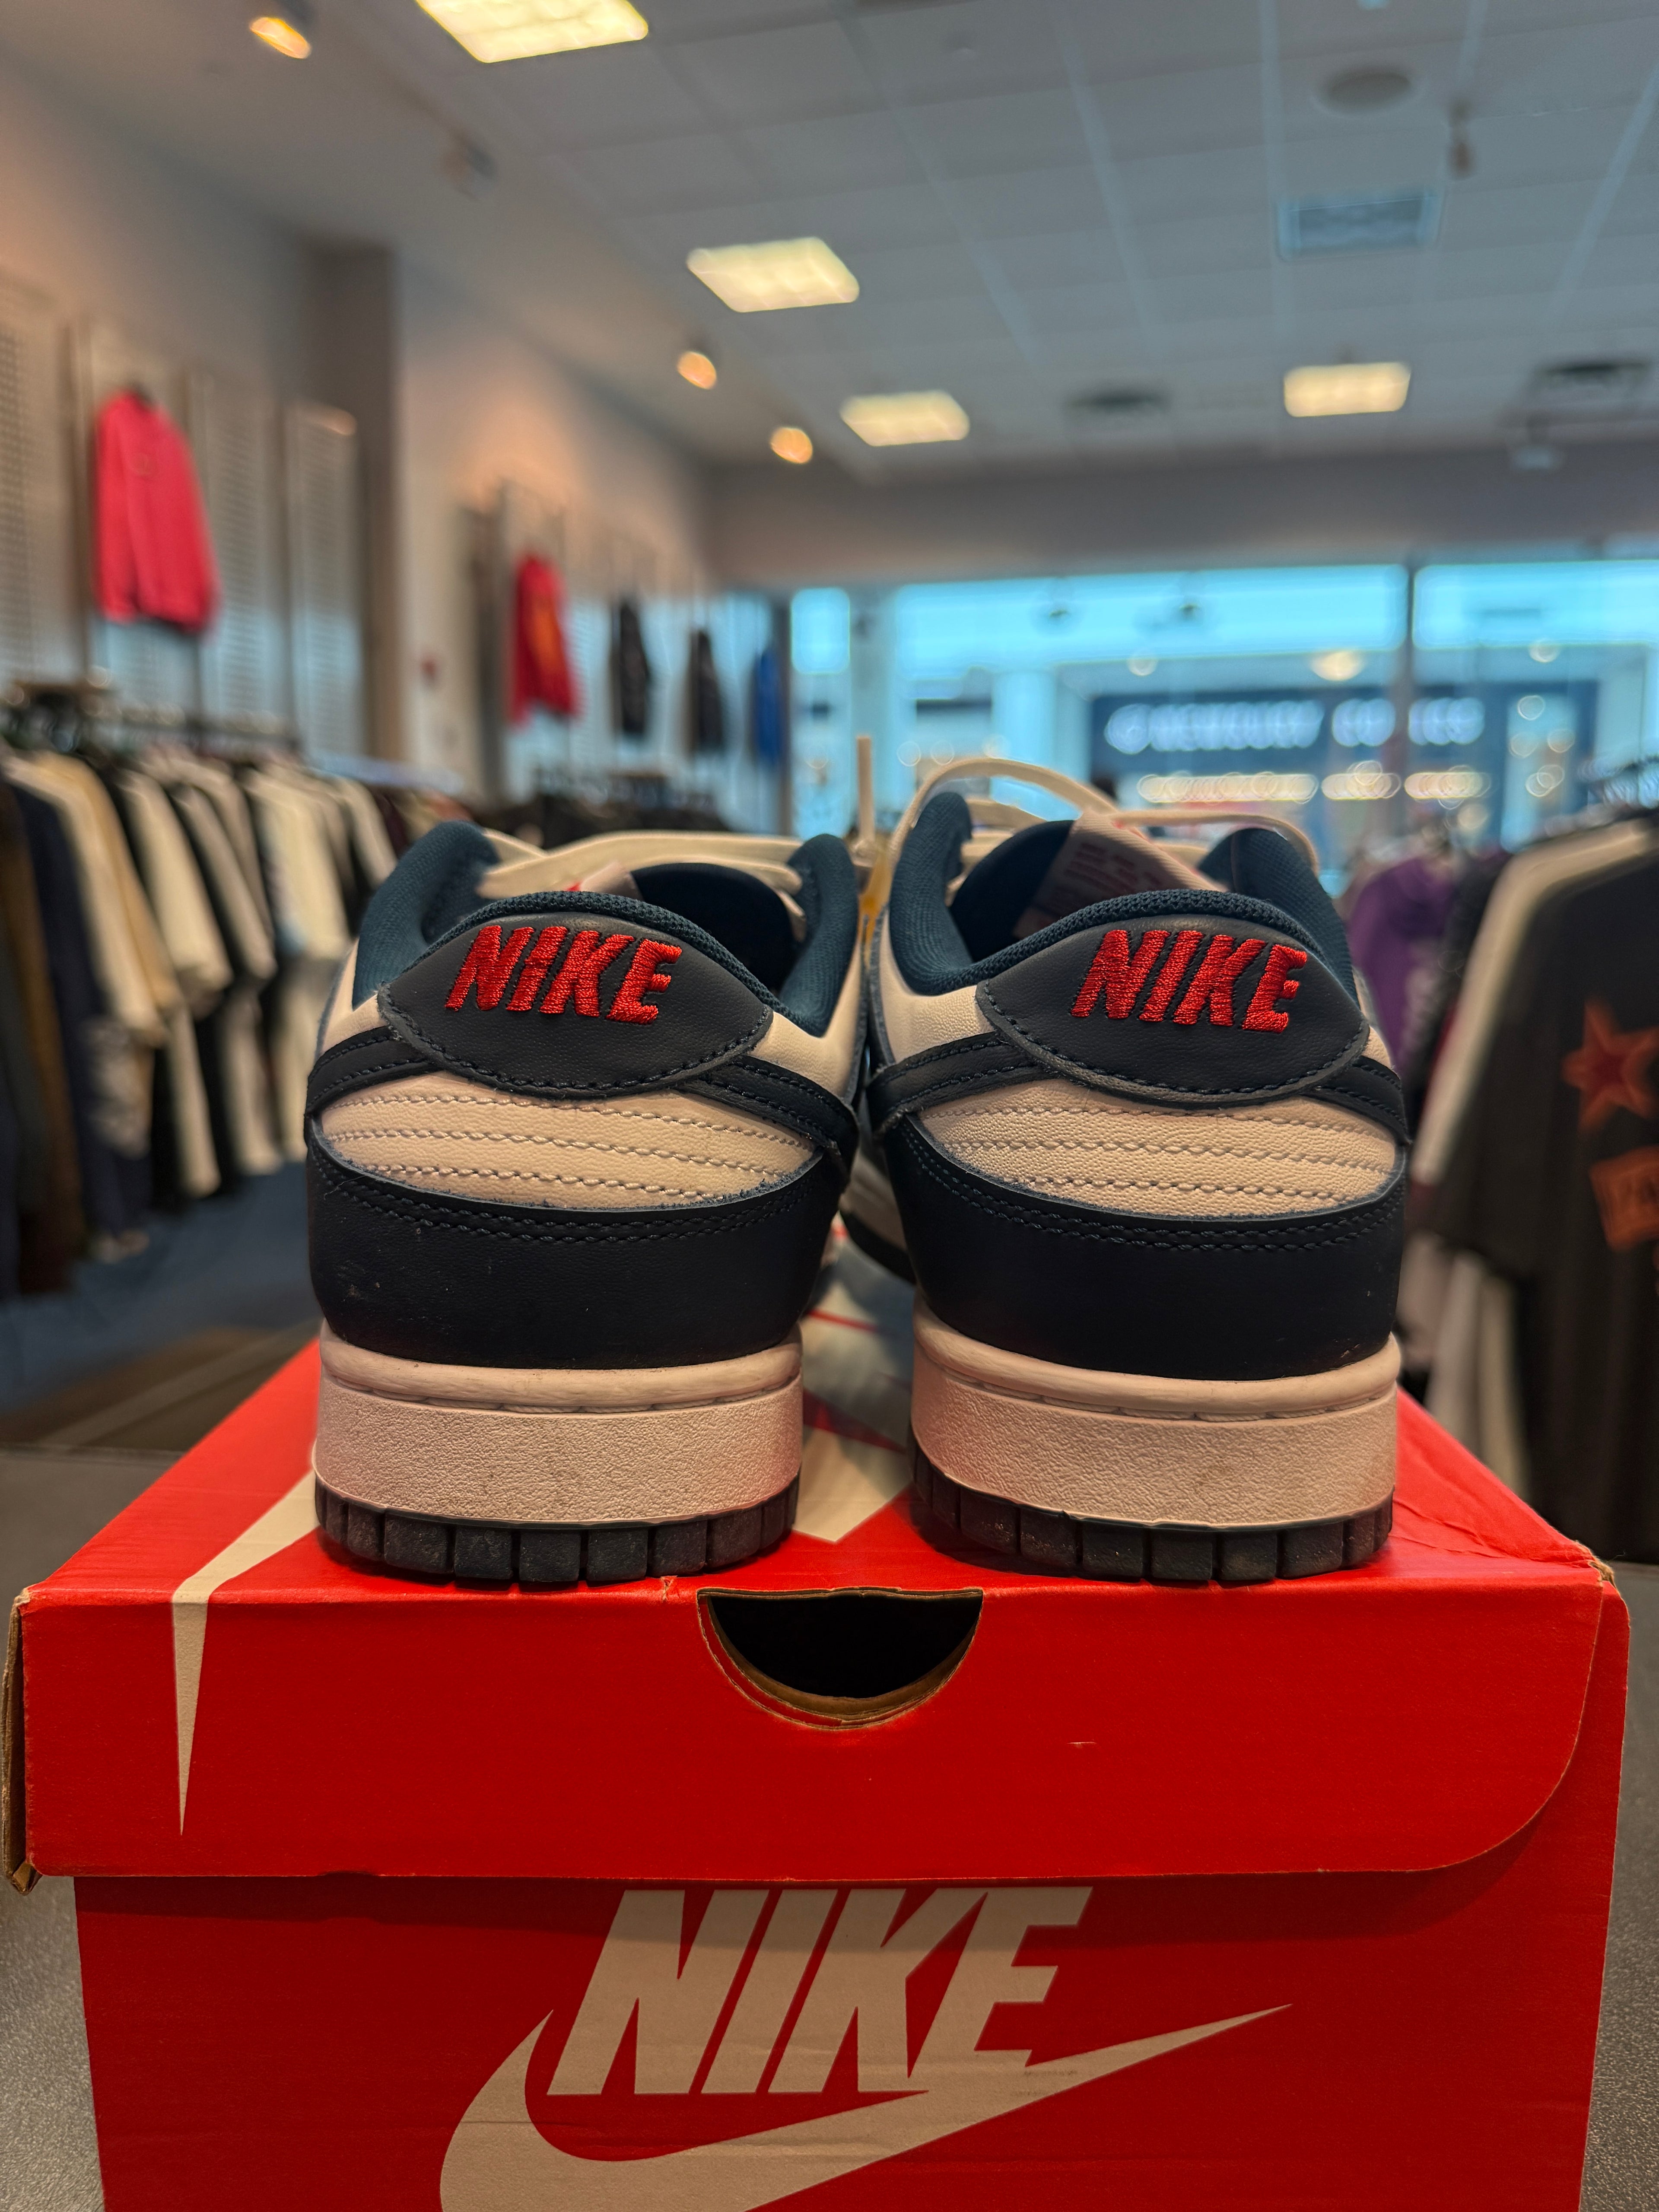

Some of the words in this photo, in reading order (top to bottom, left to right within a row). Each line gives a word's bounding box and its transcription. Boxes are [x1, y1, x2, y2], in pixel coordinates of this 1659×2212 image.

[445, 925, 682, 1025] NIKE
[1071, 929, 1307, 1033] NIKE
[546, 1886, 1093, 2095] NIKE
